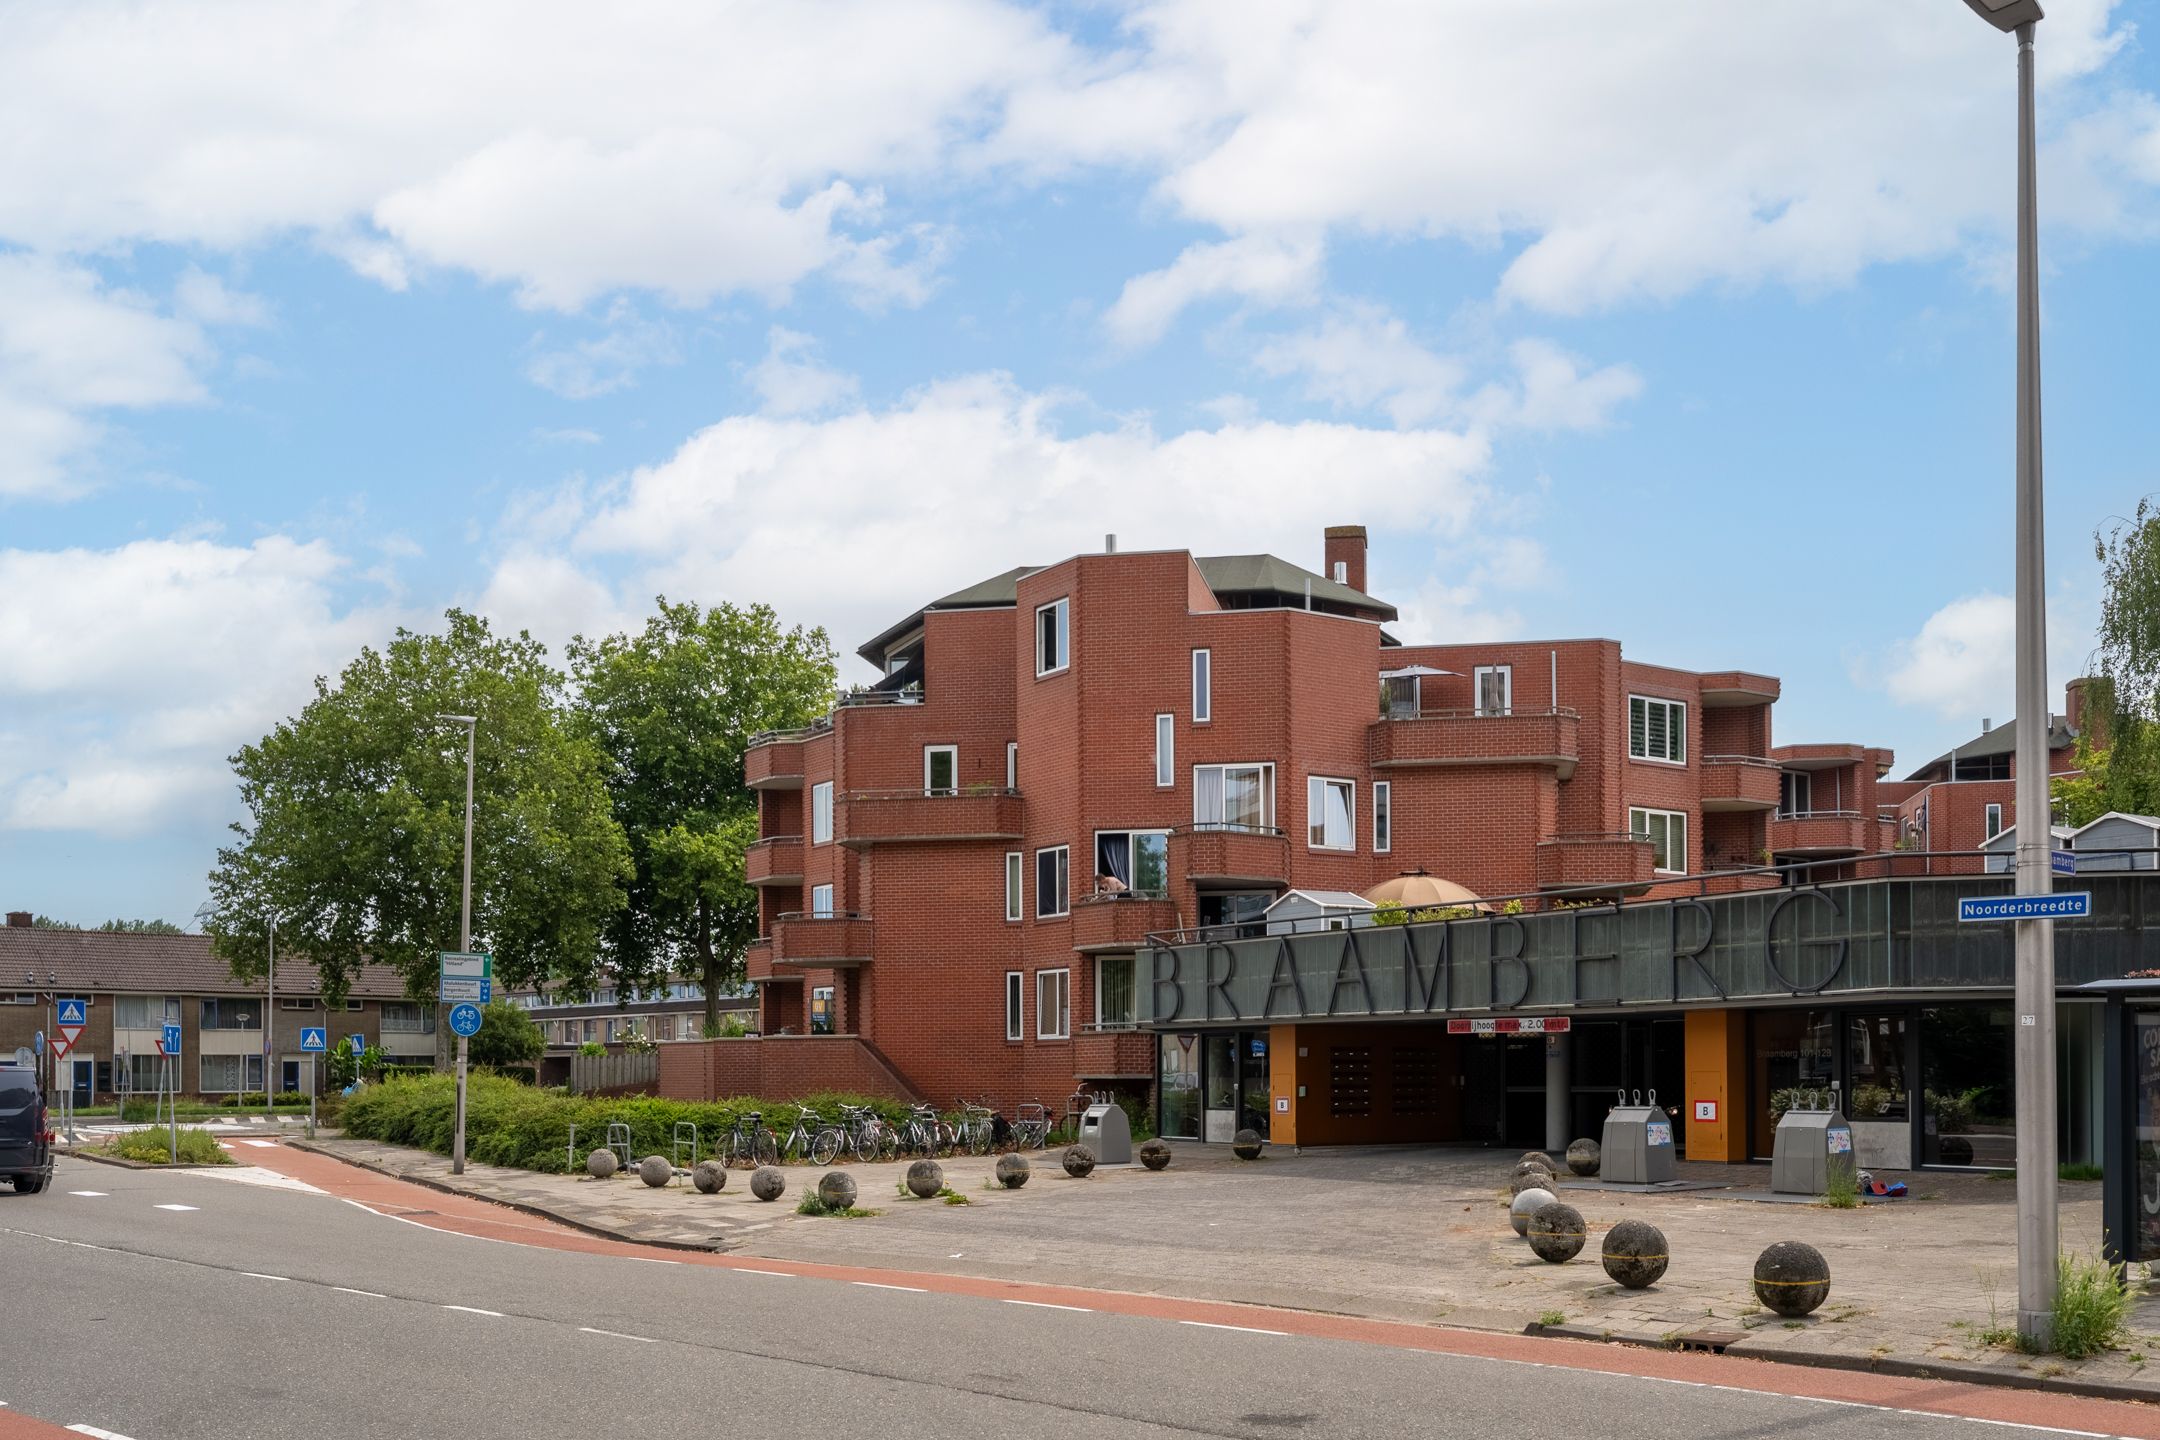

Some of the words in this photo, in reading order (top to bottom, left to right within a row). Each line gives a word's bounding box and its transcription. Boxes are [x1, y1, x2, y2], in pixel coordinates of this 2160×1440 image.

[1964, 900, 2083, 916] Noorderbreedte
[1152, 889, 1848, 1023] BRAAMBERG
[1450, 1020, 1503, 1032] Doorrijhoogte
[1527, 1019, 1546, 1029] 2.00
[2023, 1016, 2034, 1025] 27
[1702, 1106, 1709, 1116] B
